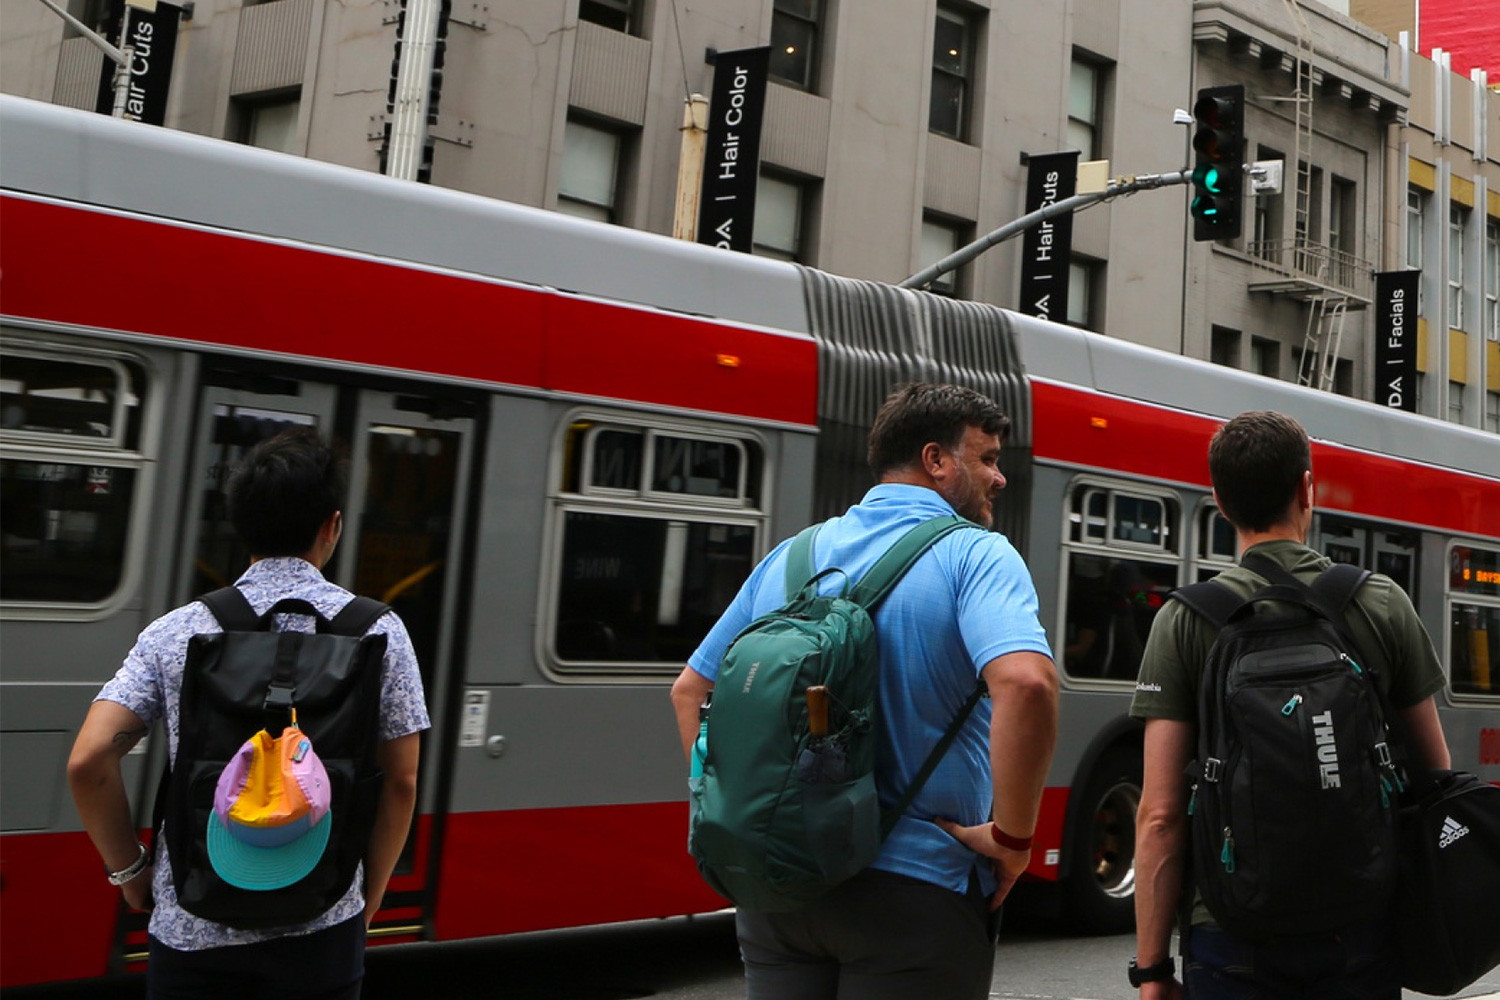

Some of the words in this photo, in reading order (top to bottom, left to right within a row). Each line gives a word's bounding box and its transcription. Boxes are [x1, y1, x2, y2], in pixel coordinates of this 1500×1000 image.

[131, 21, 154, 76] Cuts
[725, 66, 749, 127] Color
[719, 132, 741, 180] Hair
[1036, 221, 1054, 262] Hair
[1388, 288, 1405, 349] Facials
[1312, 710, 1341, 790] THULE
[1439, 825, 1470, 848] adidas
